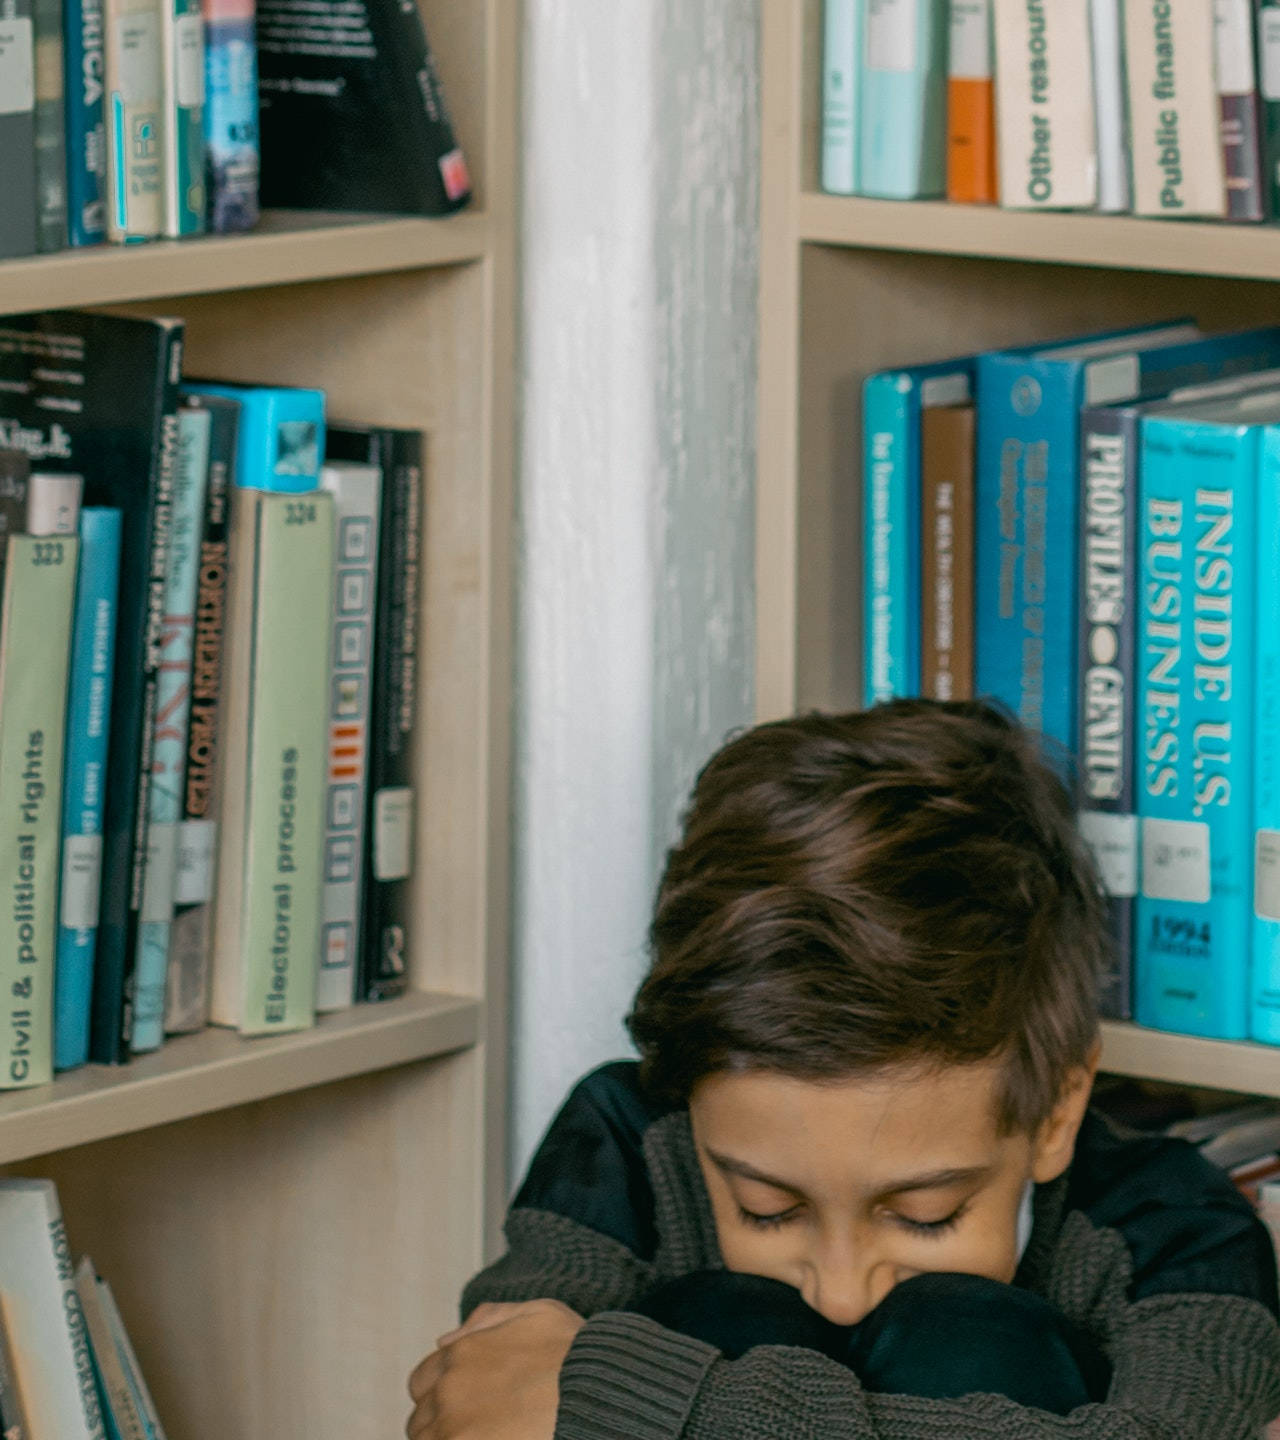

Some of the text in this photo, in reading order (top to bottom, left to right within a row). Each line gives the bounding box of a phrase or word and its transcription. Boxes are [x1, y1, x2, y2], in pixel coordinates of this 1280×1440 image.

[1027, 114, 1051, 201] Other
[1159, 109, 1183, 208] Public
[8, 730, 48, 1083] Civil & political rights
[266, 748, 299, 1023] Electoral process
